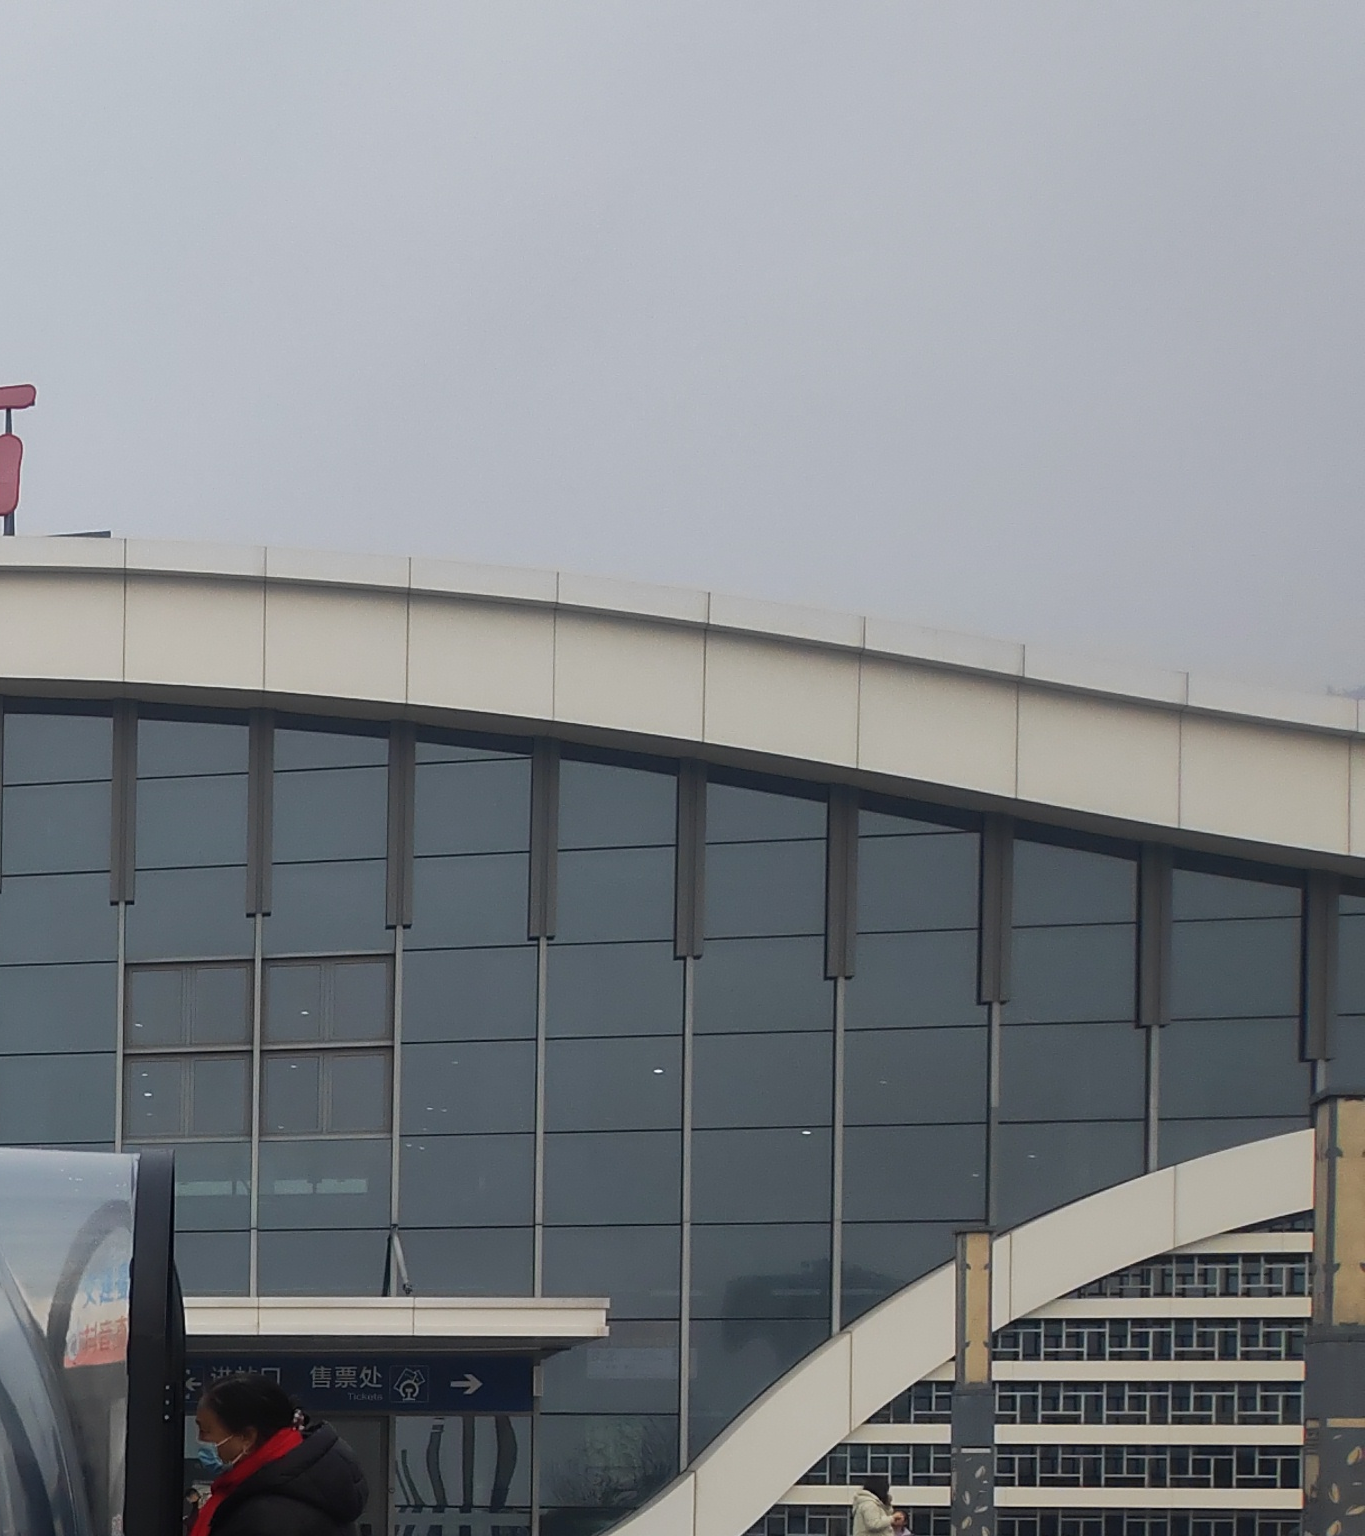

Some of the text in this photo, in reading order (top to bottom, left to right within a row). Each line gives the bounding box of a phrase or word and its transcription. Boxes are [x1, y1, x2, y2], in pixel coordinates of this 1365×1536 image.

[310, 1365, 383, 1389] 售票处
[347, 1392, 383, 1402] Tickets
